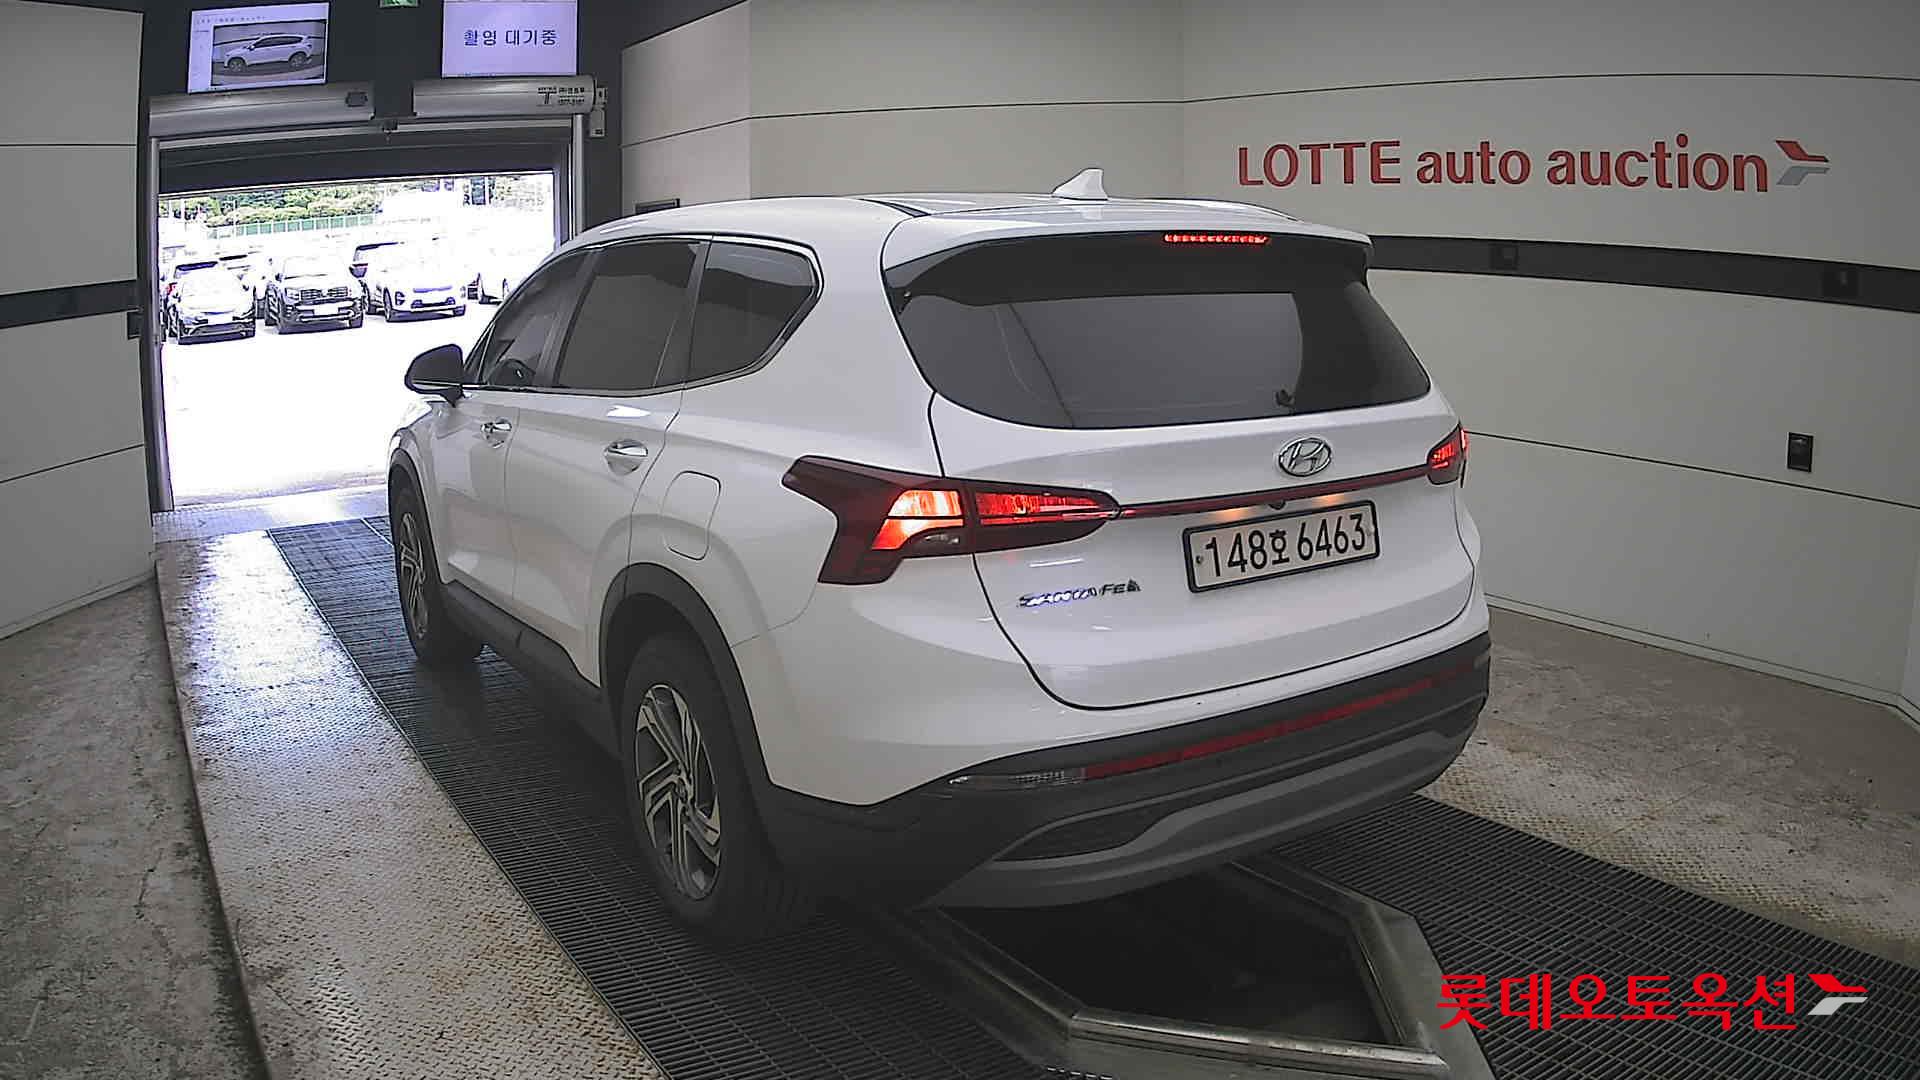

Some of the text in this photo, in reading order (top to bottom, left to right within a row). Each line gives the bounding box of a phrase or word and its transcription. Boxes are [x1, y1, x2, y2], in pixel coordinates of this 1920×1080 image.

[505, 29, 558, 46] 대기중
[1238, 133, 1768, 193] LOTTE auto auction
[1205, 513, 1366, 578] 148호 6463
